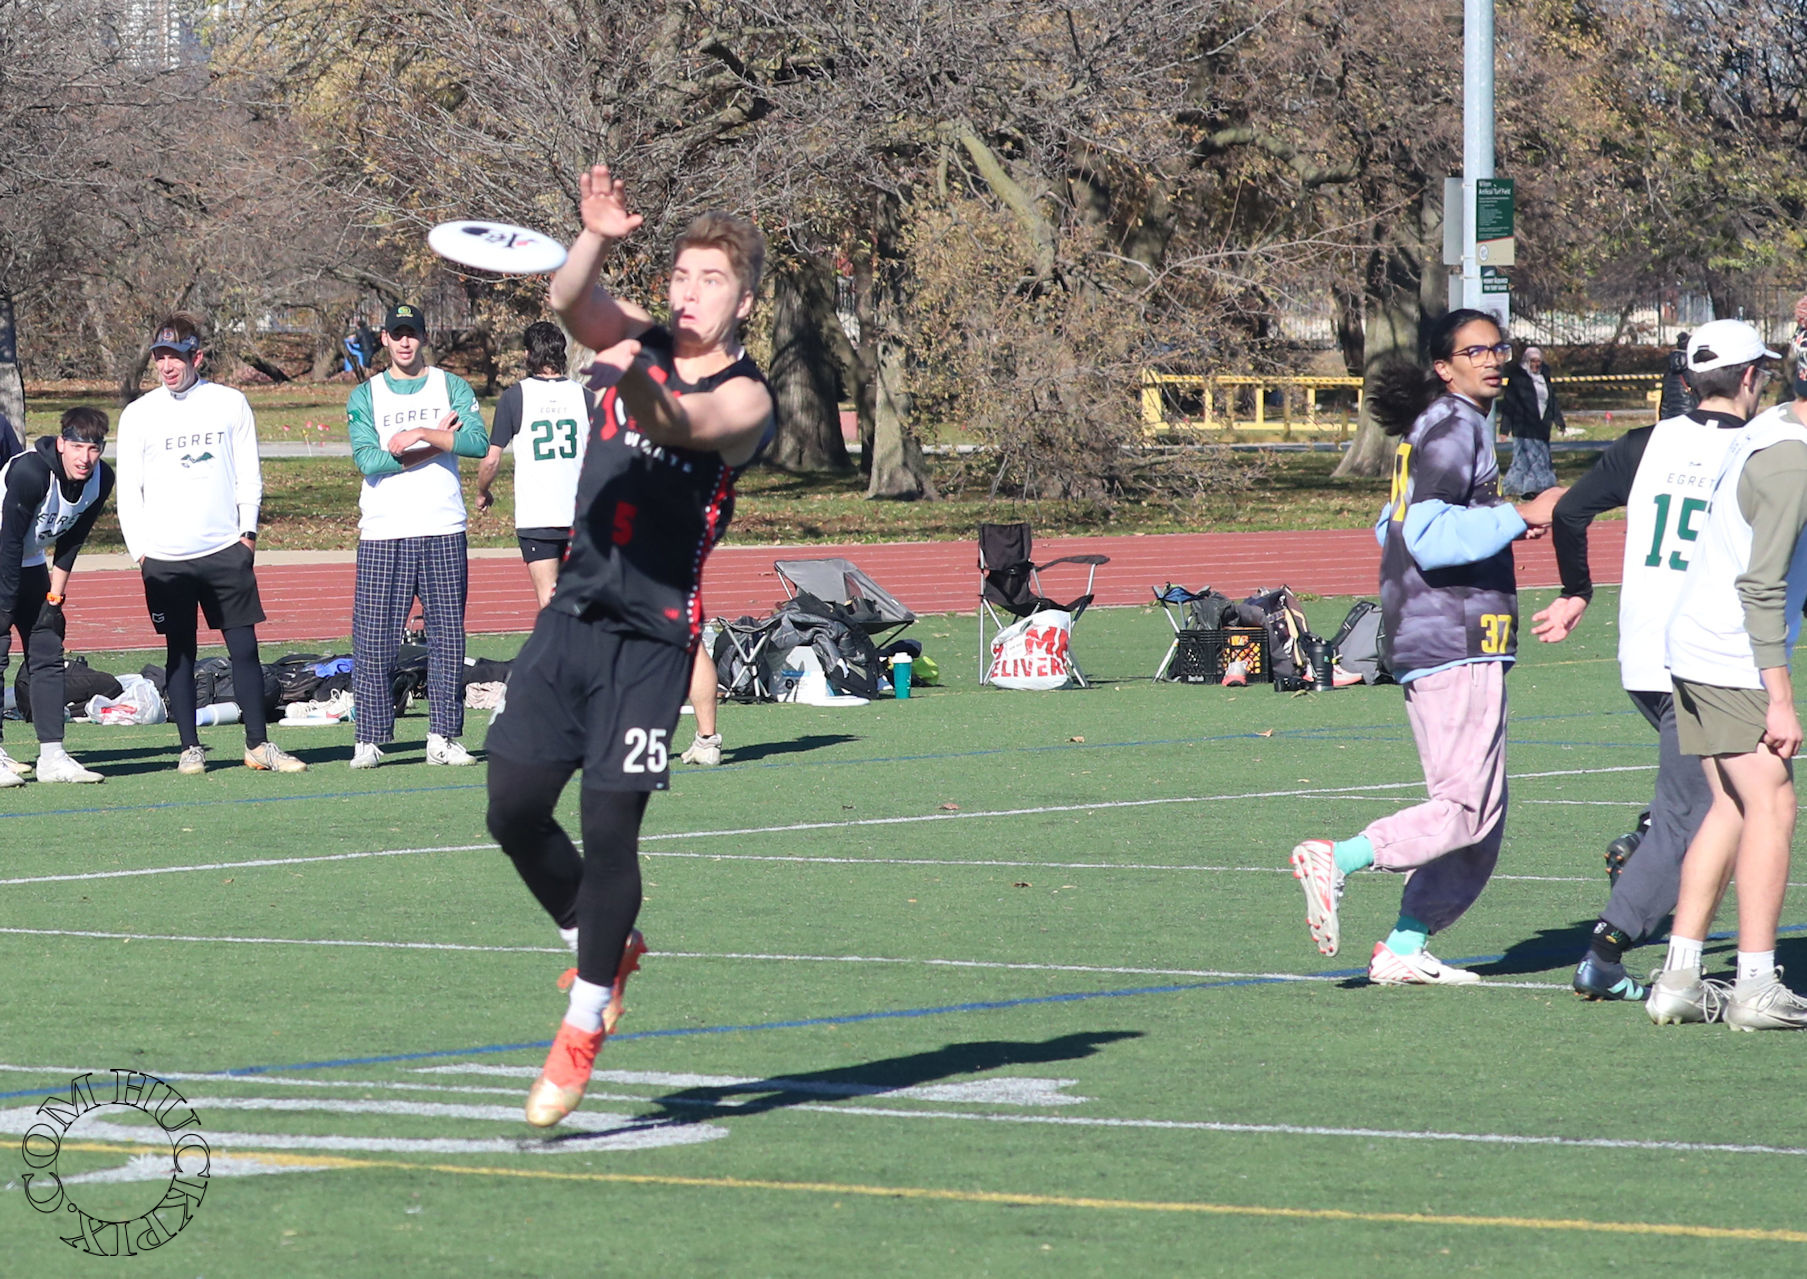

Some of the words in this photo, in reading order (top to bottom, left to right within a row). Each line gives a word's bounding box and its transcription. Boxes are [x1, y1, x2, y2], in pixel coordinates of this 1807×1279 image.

[383, 408, 441, 427] EGRET
[165, 431, 225, 451] EGRET
[531, 418, 578, 461] 23
[1644, 493, 1709, 572] 15
[1480, 613, 1512, 654] 37
[622, 727, 668, 774] 25
